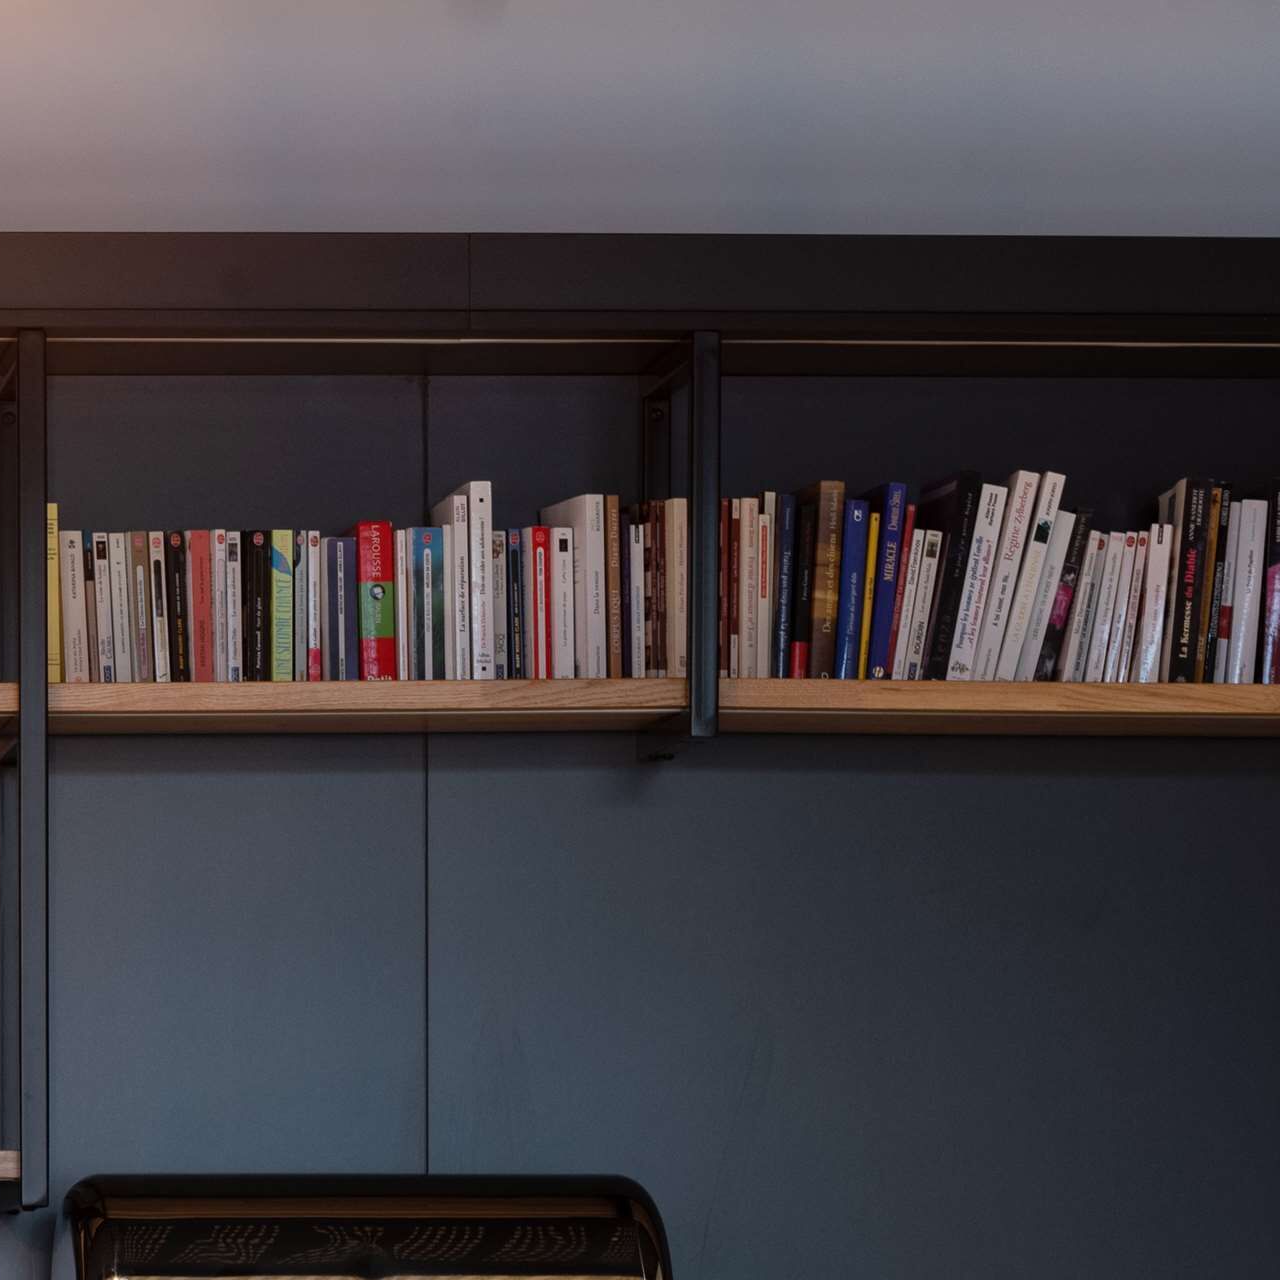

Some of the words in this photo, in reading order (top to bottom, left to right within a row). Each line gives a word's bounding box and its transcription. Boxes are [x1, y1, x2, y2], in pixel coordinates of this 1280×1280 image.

[370, 524, 382, 578] LAROUSSE
[1003, 525, 1021, 562] Régine
[458, 555, 467, 590] réparation
[882, 540, 897, 583] MIRACLE
[1183, 547, 1198, 584] Diable
[458, 590, 466, 599] de
[593, 591, 599, 599] la
[1185, 585, 1194, 599] du
[459, 623, 466, 633] La
[913, 620, 925, 655] BOURDIN
[956, 623, 968, 649] Pourquoi
[1180, 600, 1193, 644] Kermesse
[1178, 646, 1188, 659] La
